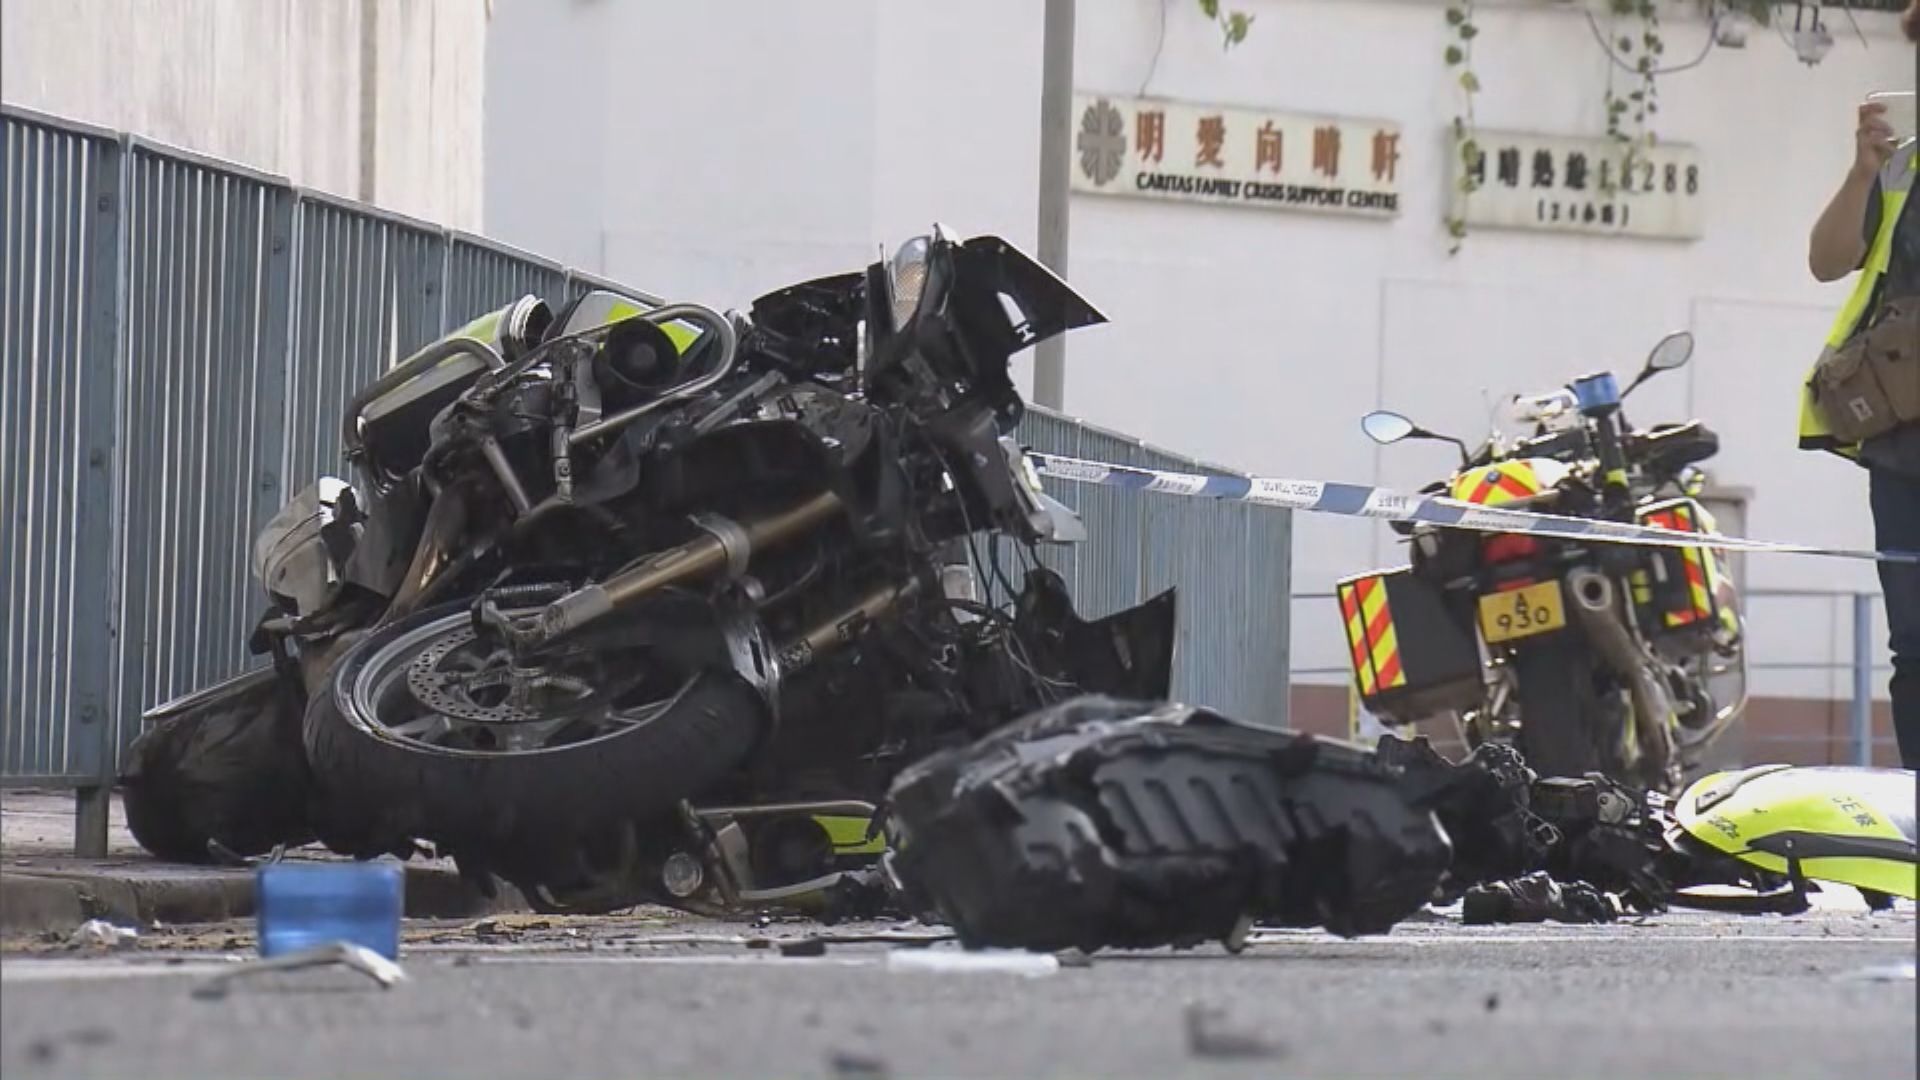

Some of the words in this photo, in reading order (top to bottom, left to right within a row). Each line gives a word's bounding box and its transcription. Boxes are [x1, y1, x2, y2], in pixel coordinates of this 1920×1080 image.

[1136, 110, 1400, 183] 明愛向晴軒
[1136, 171, 1193, 193] CARITAS
[1195, 175, 1241, 198] FAMILY
[1243, 181, 1284, 200] CRISIS
[1286, 183, 1344, 206] SUPPORT
[1347, 189, 1398, 212] CENTRE
[1496, 605, 1550, 632] 930
[1514, 591, 1529, 615] A
